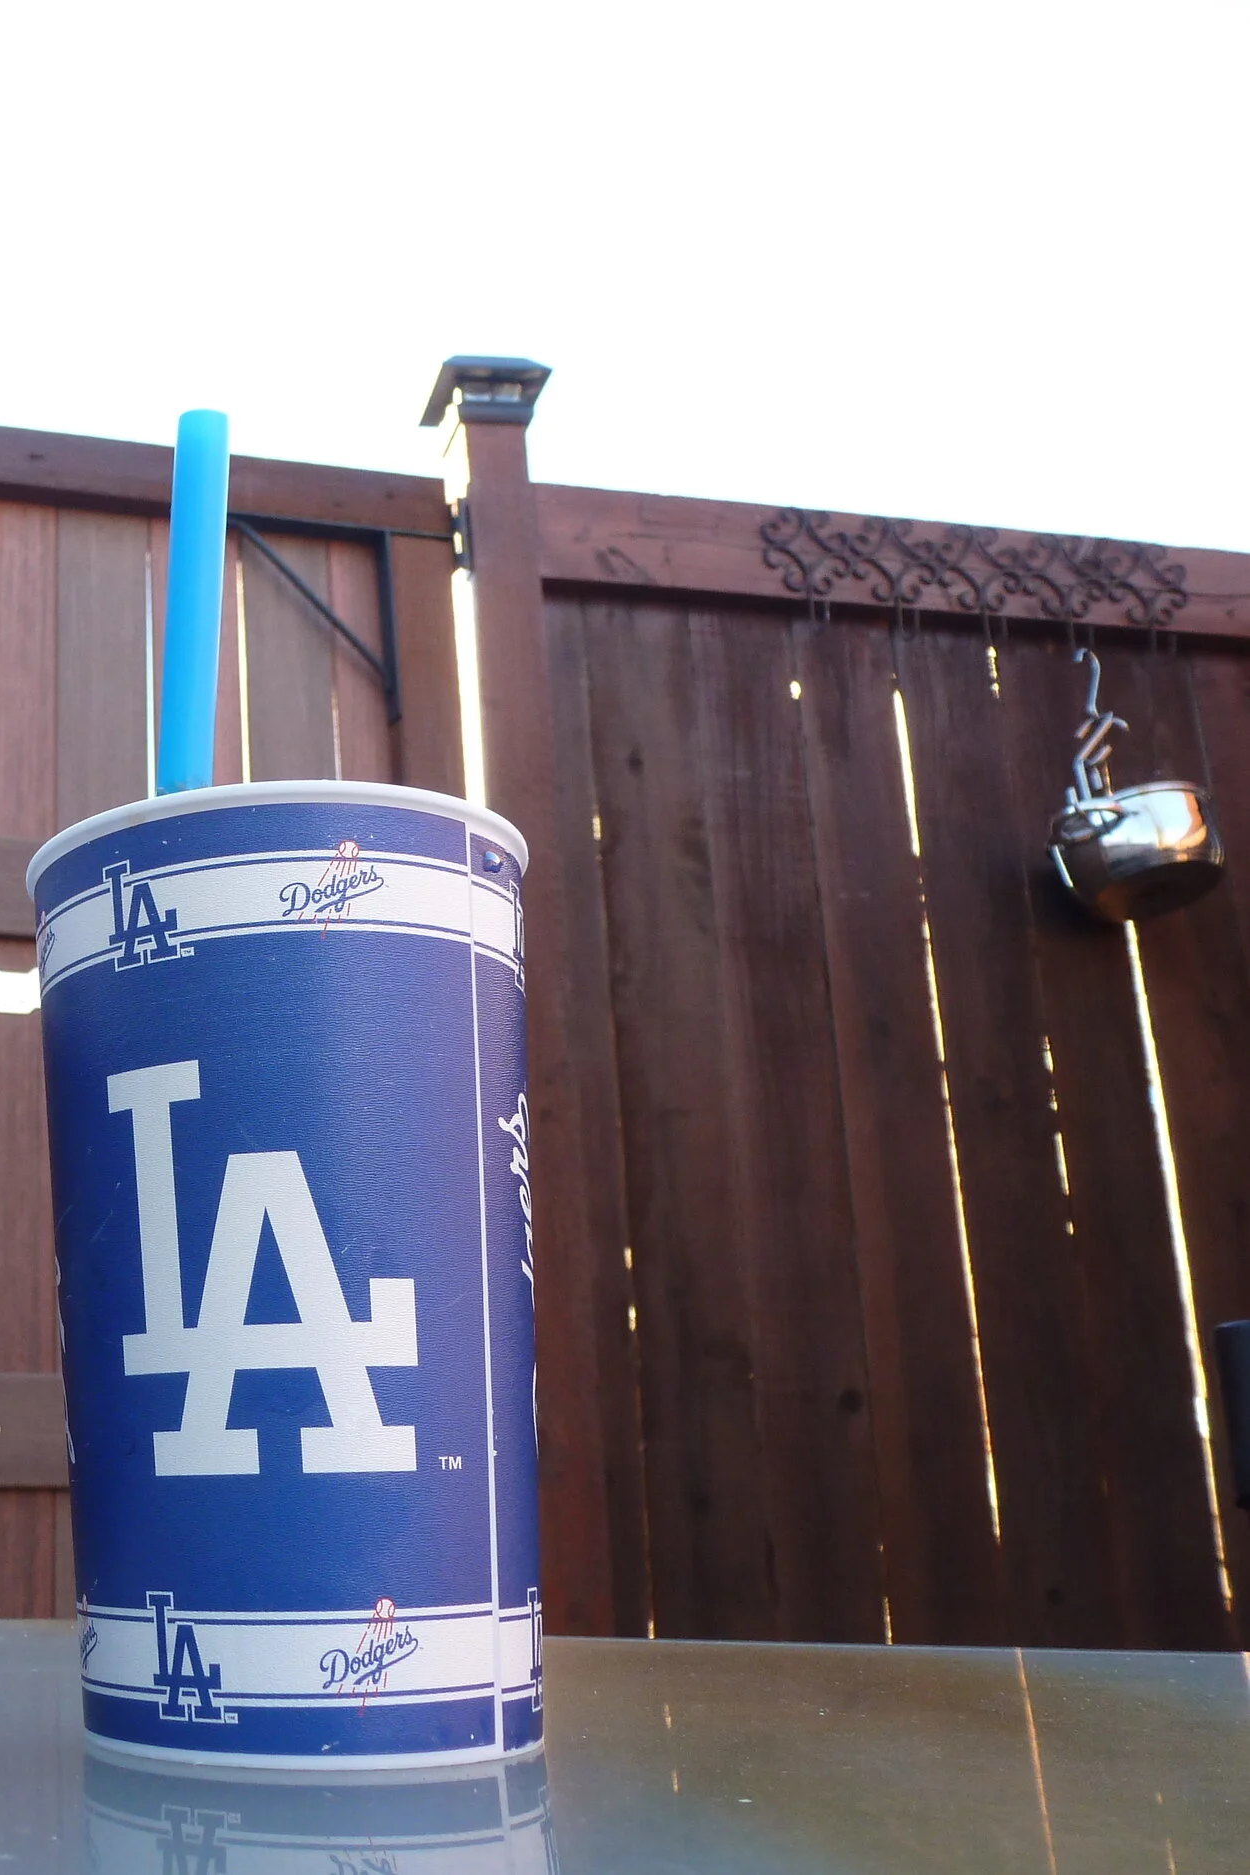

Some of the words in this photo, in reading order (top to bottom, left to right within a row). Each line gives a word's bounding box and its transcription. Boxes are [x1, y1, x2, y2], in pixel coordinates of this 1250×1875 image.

[103, 860, 181, 972] LA
[279, 865, 384, 917] Dodgers
[107, 1059, 418, 1477] LA
[439, 1456, 462, 1470] TM
[146, 1591, 225, 1723] LA
[320, 1625, 418, 1689] Dodgers
